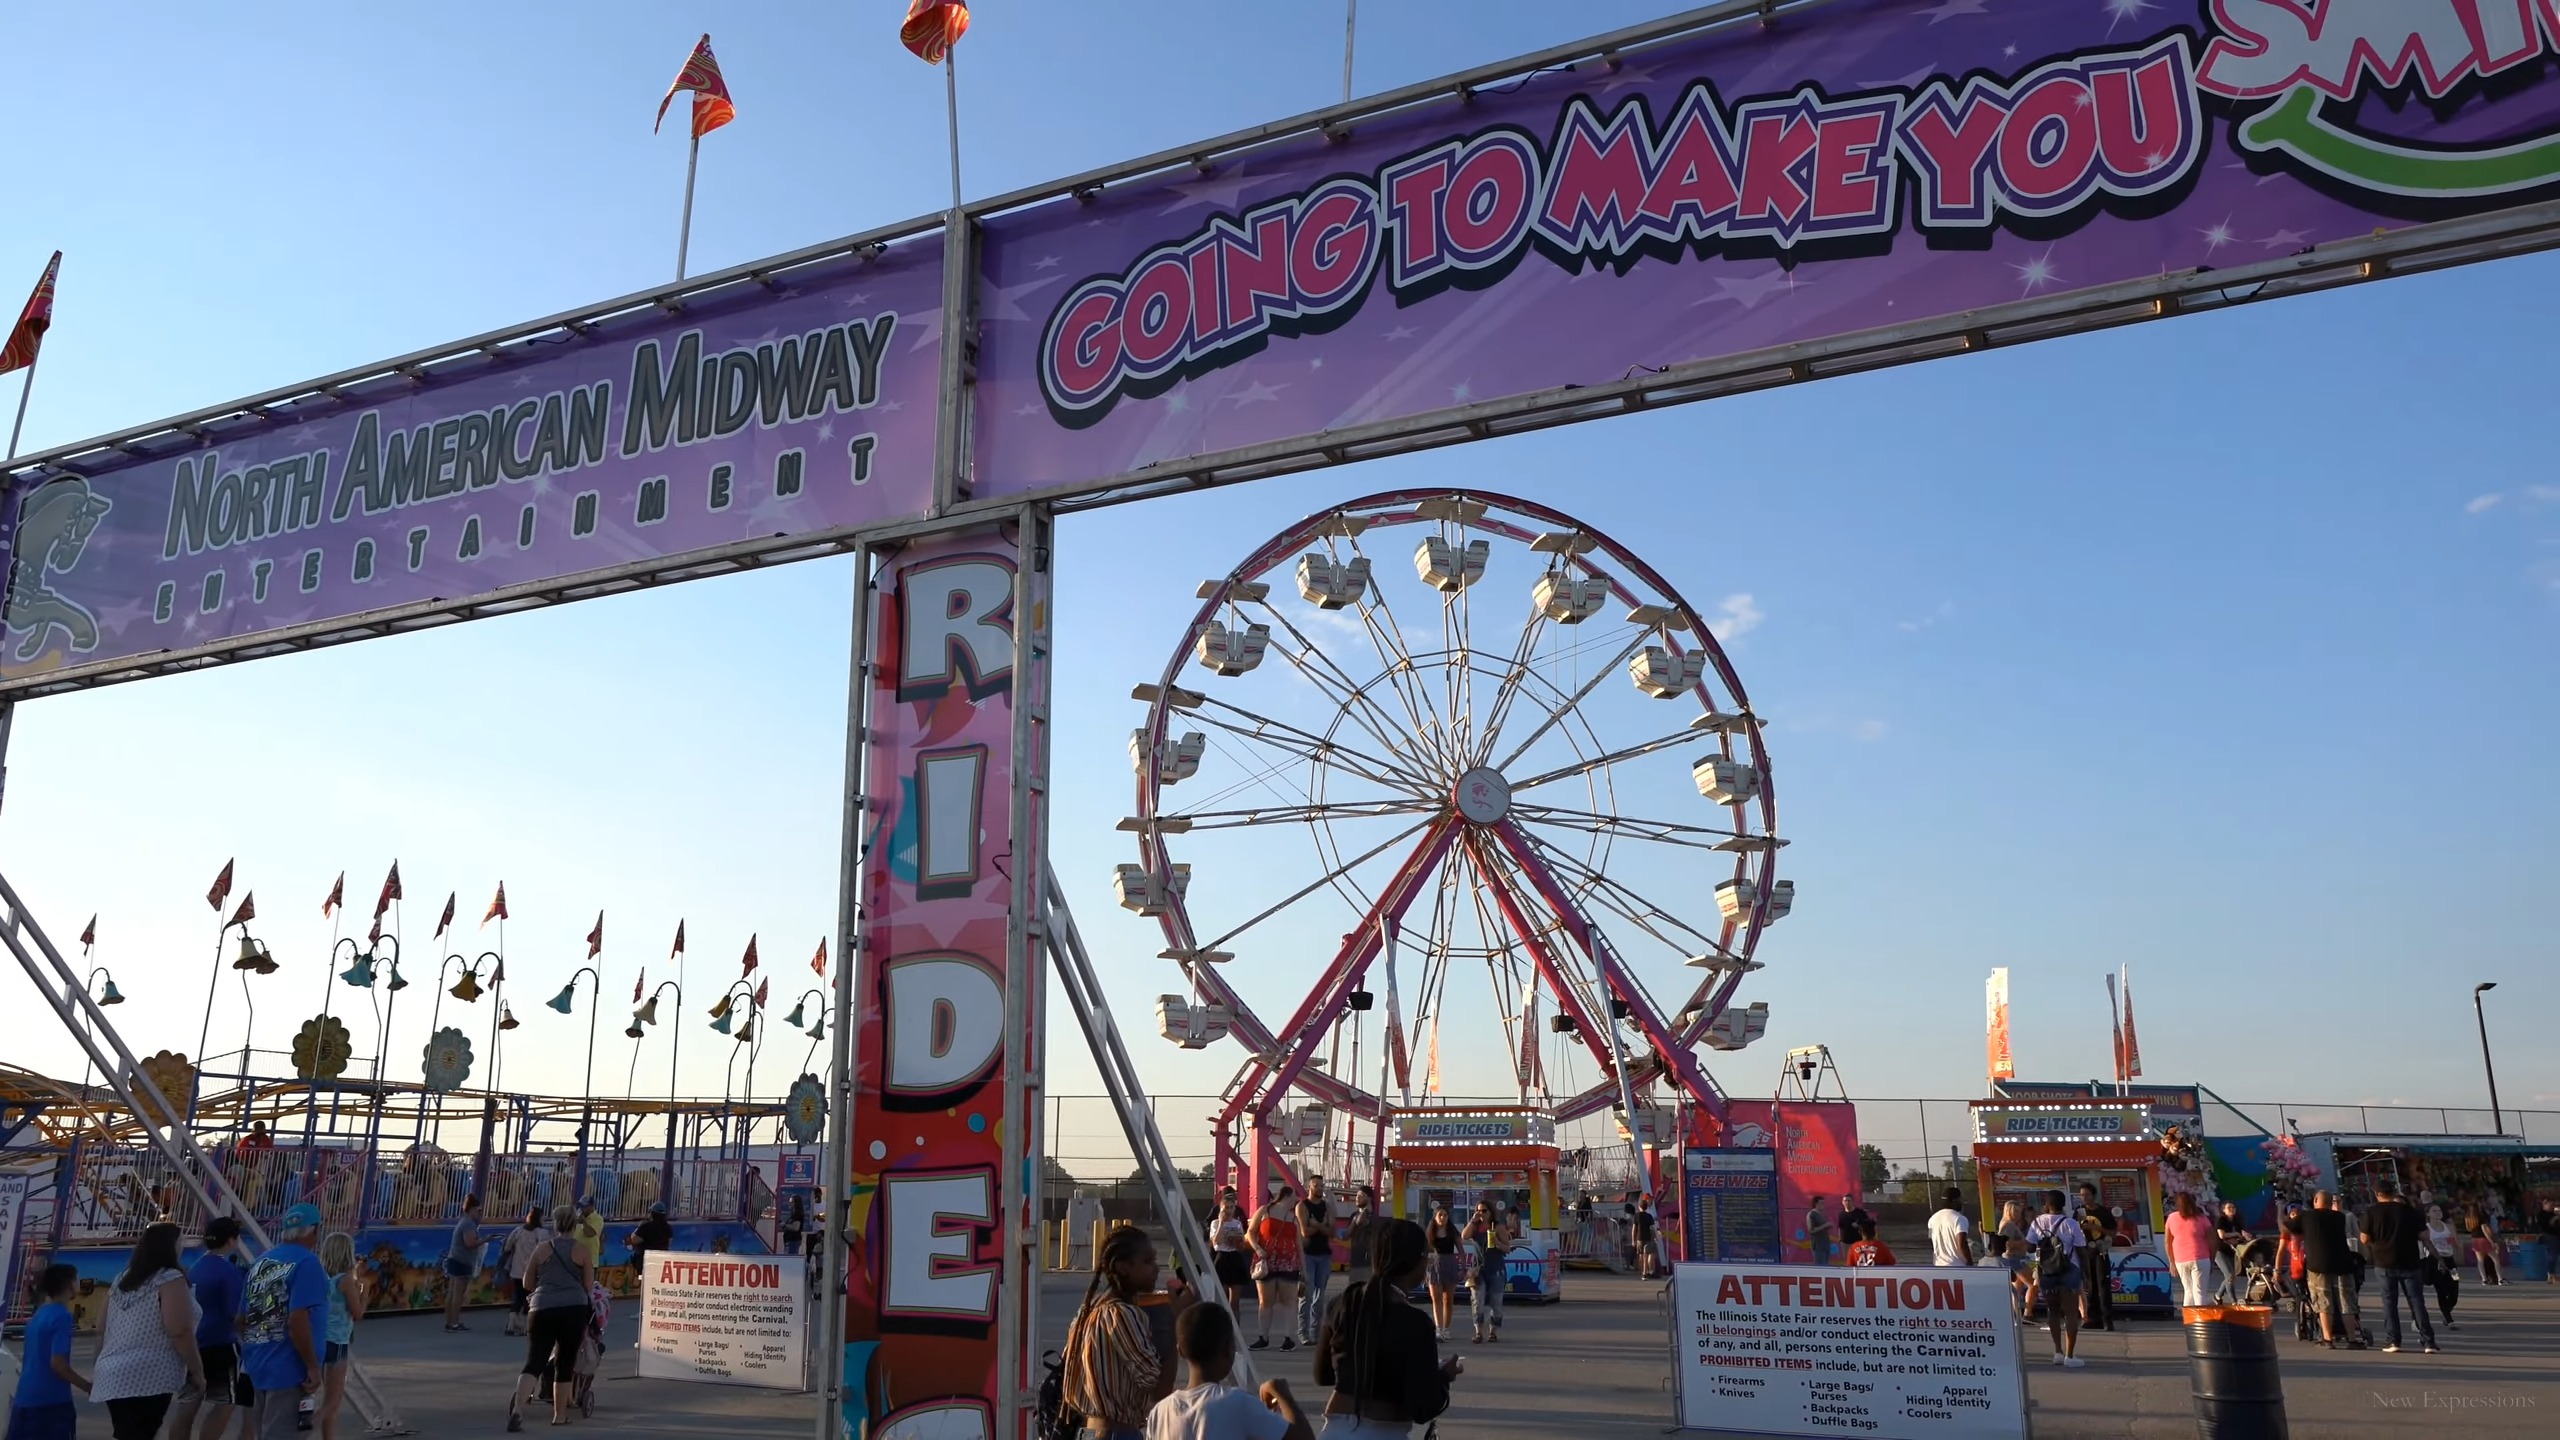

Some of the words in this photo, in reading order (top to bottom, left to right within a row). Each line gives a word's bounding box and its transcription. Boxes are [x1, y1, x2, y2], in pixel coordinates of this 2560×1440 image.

[2197, 0, 2560, 100] SMI
[1040, 178, 1382, 415] GOING
[1382, 130, 1541, 292] TO
[1538, 85, 1903, 256] MAKE
[1897, 33, 2201, 229] YOU
[163, 448, 325, 559] NORTH
[332, 379, 610, 521] AMERICAN
[620, 311, 895, 460] MIDWAY
[153, 434, 877, 624] ENTERTAINMENT
[880, 553, 1018, 1440] RIDE
[1417, 1122, 1454, 1136] RIDE
[1454, 1122, 1512, 1137] TICKETS
[2006, 1117, 2049, 1132] RIDE
[2050, 1116, 2122, 1132] TICKETS
[1690, 1175, 1725, 1188] SIZE
[1727, 1175, 1769, 1188] WIZE
[660, 1261, 780, 1288] ATTENTION
[651, 1287, 660, 1295] The
[661, 1288, 678, 1297] Illinois
[679, 1289, 693, 1298] State
[694, 1290, 705, 1298] Fair
[706, 1292, 730, 1300] reserves
[732, 1292, 742, 1300] the
[743, 1292, 760, 1303] right
[770, 1294, 793, 1302] search
[1715, 1275, 1966, 1311] ATTENTION
[658, 1298, 686, 1309] belongings
[687, 1301, 704, 1309] and/or
[706, 1302, 729, 1311] conduct
[730, 1303, 761, 1312] electronic
[763, 1305, 793, 1315] wanding
[651, 1308, 656, 1316] of
[657, 1310, 667, 1319] any,
[668, 1310, 678, 1318] and
[679, 1310, 687, 1319] all,
[688, 1313, 710, 1321] persons
[712, 1313, 737, 1324] entering
[739, 1314, 749, 1322] the
[752, 1314, 788, 1324] Carnival.
[1696, 1310, 1716, 1321] The
[1719, 1311, 1757, 1322] Illinois
[1761, 1312, 1791, 1323] State
[1794, 1313, 1817, 1324] Fair
[1820, 1315, 1871, 1326] reserves
[1875, 1315, 1895, 1326] the
[1899, 1316, 1930, 1329] right
[1934, 1317, 1947, 1328] to
[1951, 1318, 1992, 1329] search
[650, 1321, 681, 1330] PROHIBITED
[683, 1323, 700, 1332] ITEMS
[702, 1325, 723, 1334] include,
[725, 1326, 734, 1335] but
[746, 1328, 757, 1336] not
[758, 1328, 781, 1337] limited
[1696, 1324, 1710, 1334] all
[1713, 1325, 1777, 1339] belongings
[1780, 1327, 1817, 1338] and/or
[1821, 1329, 1869, 1340] conduct
[1873, 1330, 1935, 1342] electronic
[1938, 1332, 1995, 1347] wanding
[657, 1337, 678, 1345] Firearms
[698, 1340, 713, 1349] Large
[714, 1341, 729, 1350] Bags/
[762, 1344, 786, 1353] Apparel
[1698, 1337, 1710, 1348] of
[1713, 1340, 1736, 1351] any,
[1739, 1340, 1761, 1350] and
[1764, 1341, 1782, 1352] all,
[1785, 1344, 1832, 1354] persons
[1835, 1344, 1888, 1358] entering
[1891, 1345, 1913, 1356] the
[1916, 1345, 1986, 1358] Carnival.
[656, 1346, 673, 1354] Knives
[744, 1352, 762, 1361] Hiding
[763, 1352, 787, 1362] Identity
[698, 1358, 727, 1366] Backpacks
[744, 1361, 767, 1369] Coolers
[1699, 1354, 1771, 1367] PROHIBITED
[1774, 1358, 1813, 1369] ITEMS
[1815, 1359, 1860, 1372] include,
[1863, 1361, 1883, 1372] but
[1887, 1364, 1905, 1373] are
[1909, 1364, 1929, 1374] not
[1932, 1363, 1976, 1376] limited
[1980, 1366, 1996, 1376] to:
[699, 1367, 716, 1375] Duffle
[718, 1369, 732, 1377] Bags
[1718, 1375, 1765, 1387] Firearms
[1809, 1380, 1841, 1392] Large
[1843, 1381, 1874, 1393] Bags/
[1719, 1387, 1755, 1399] Knives
[1811, 1391, 1848, 1401] Purses
[1942, 1385, 1988, 1398] Apparel
[1810, 1403, 1869, 1416] Backpacks
[1906, 1395, 1943, 1408] Hiding
[1946, 1397, 1991, 1410] Identity
[1907, 1408, 1952, 1420] Coolers
[1811, 1416, 1847, 1427] Duffle
[1850, 1418, 1878, 1430] Bags
